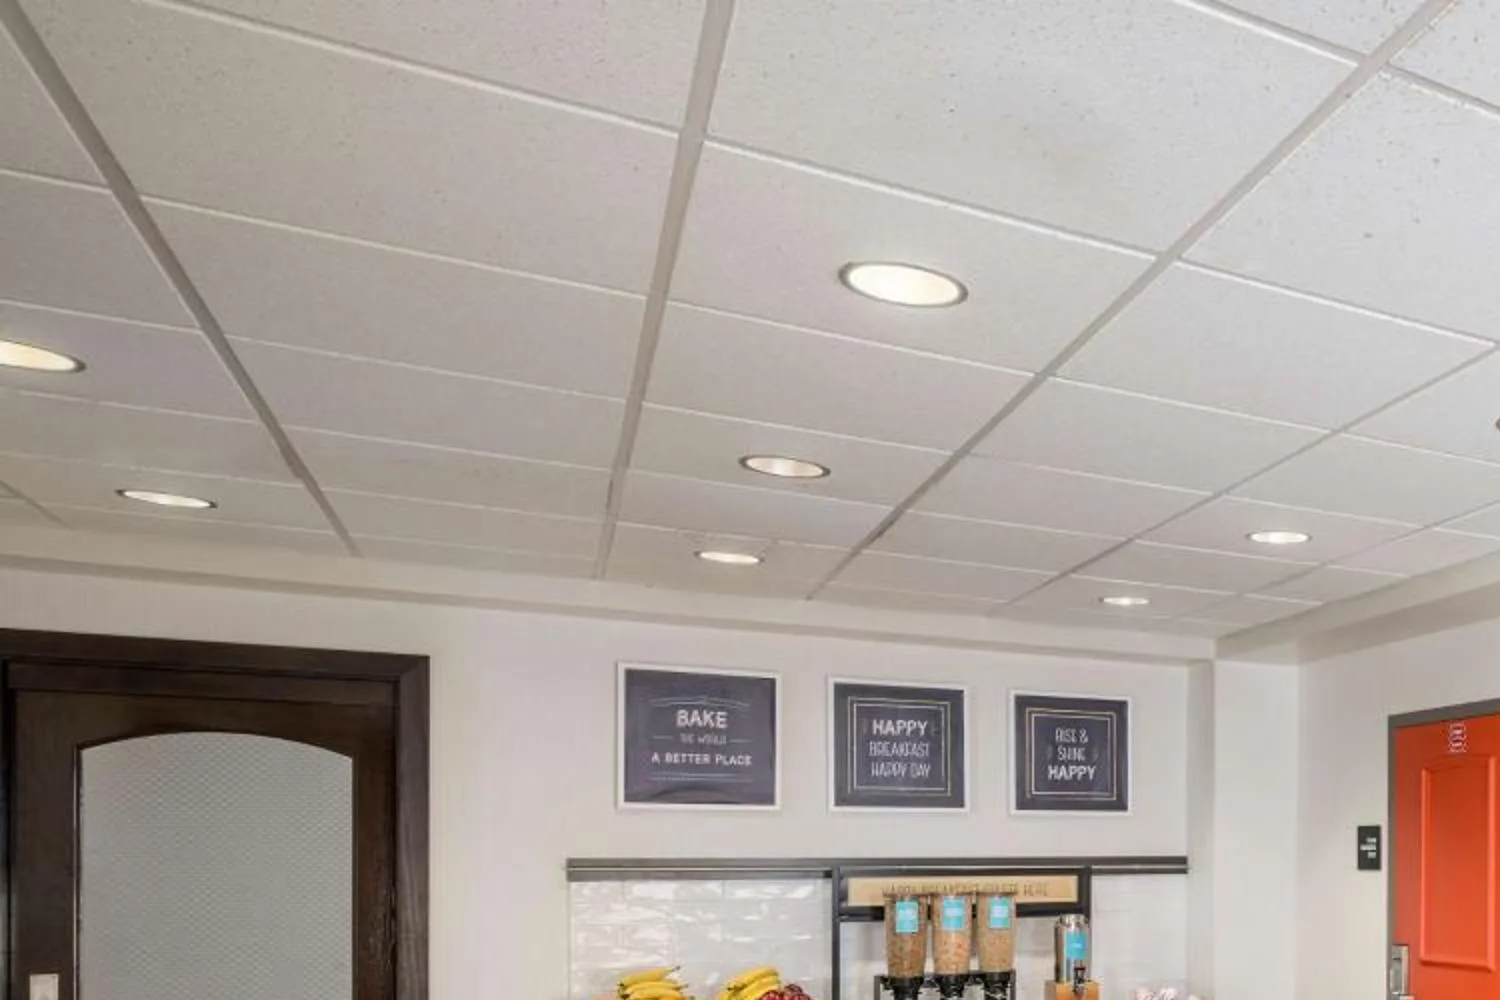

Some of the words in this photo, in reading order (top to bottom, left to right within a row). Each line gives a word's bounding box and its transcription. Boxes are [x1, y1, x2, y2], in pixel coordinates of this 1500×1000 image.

[676, 709, 728, 729] BAKE
[872, 719, 928, 737] HAPPY
[1079, 728, 1089, 744] &
[869, 741, 929, 757] BREAKFAST
[651, 752, 660, 764] A
[665, 752, 711, 765] BETTER
[715, 754, 752, 766] PLACE
[871, 761, 907, 777] HAPPY
[910, 762, 931, 778] DAY
[1047, 765, 1097, 781] HAPPY
